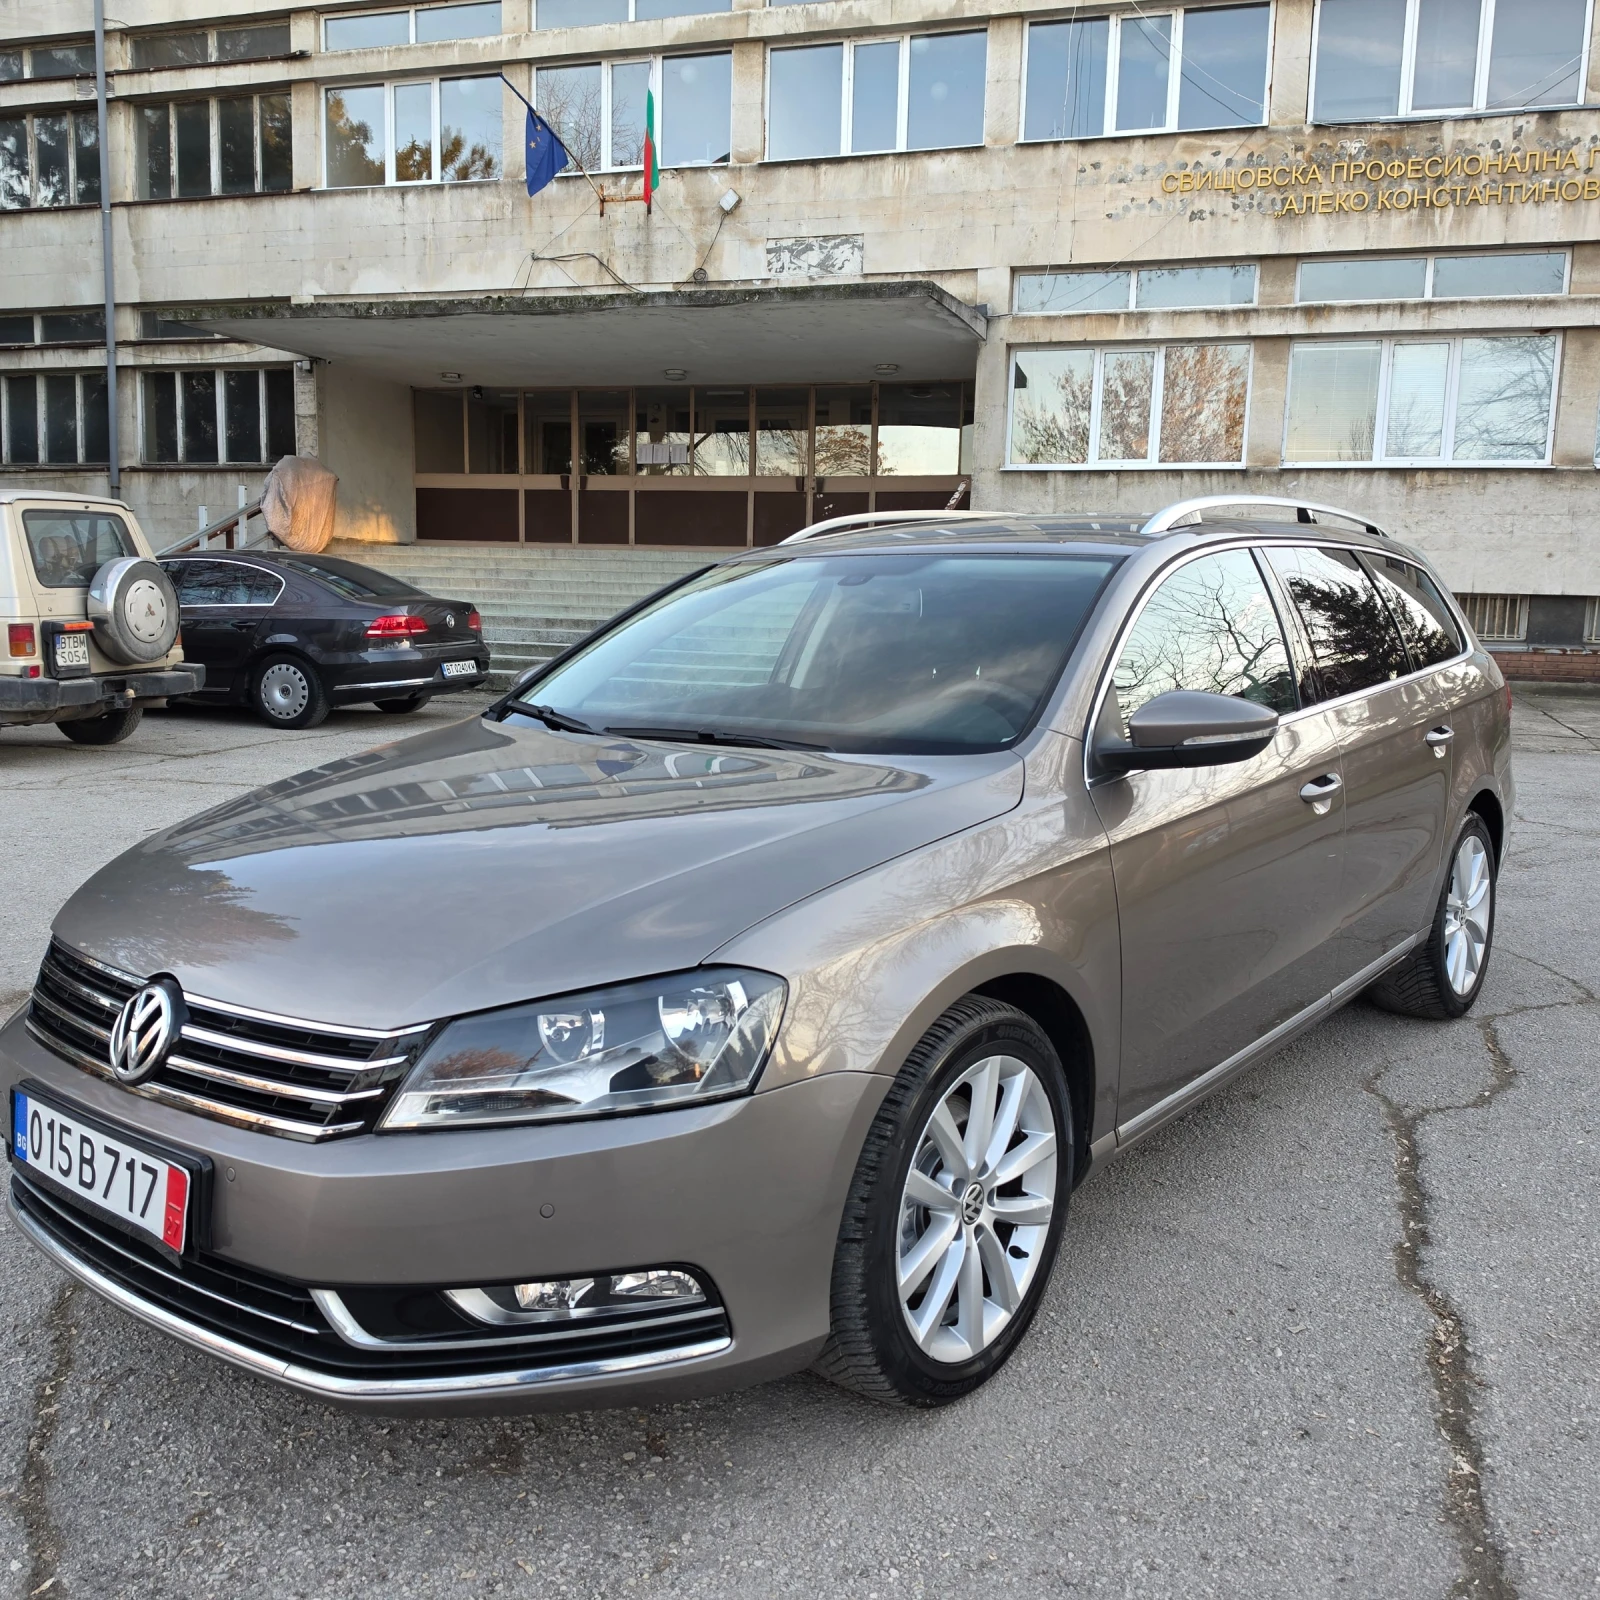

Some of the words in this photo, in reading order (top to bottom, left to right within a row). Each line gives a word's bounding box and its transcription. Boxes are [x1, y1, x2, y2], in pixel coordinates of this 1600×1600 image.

[1162, 164, 1323, 193] СВИЩОВСКА
[1331, 150, 1580, 183] ПРОФЕСИОНАЛНА
[1377, 180, 1600, 210] КОНСТАНТИНОВ
[60, 650, 87, 663] 5054
[17, 1131, 27, 1151] BG
